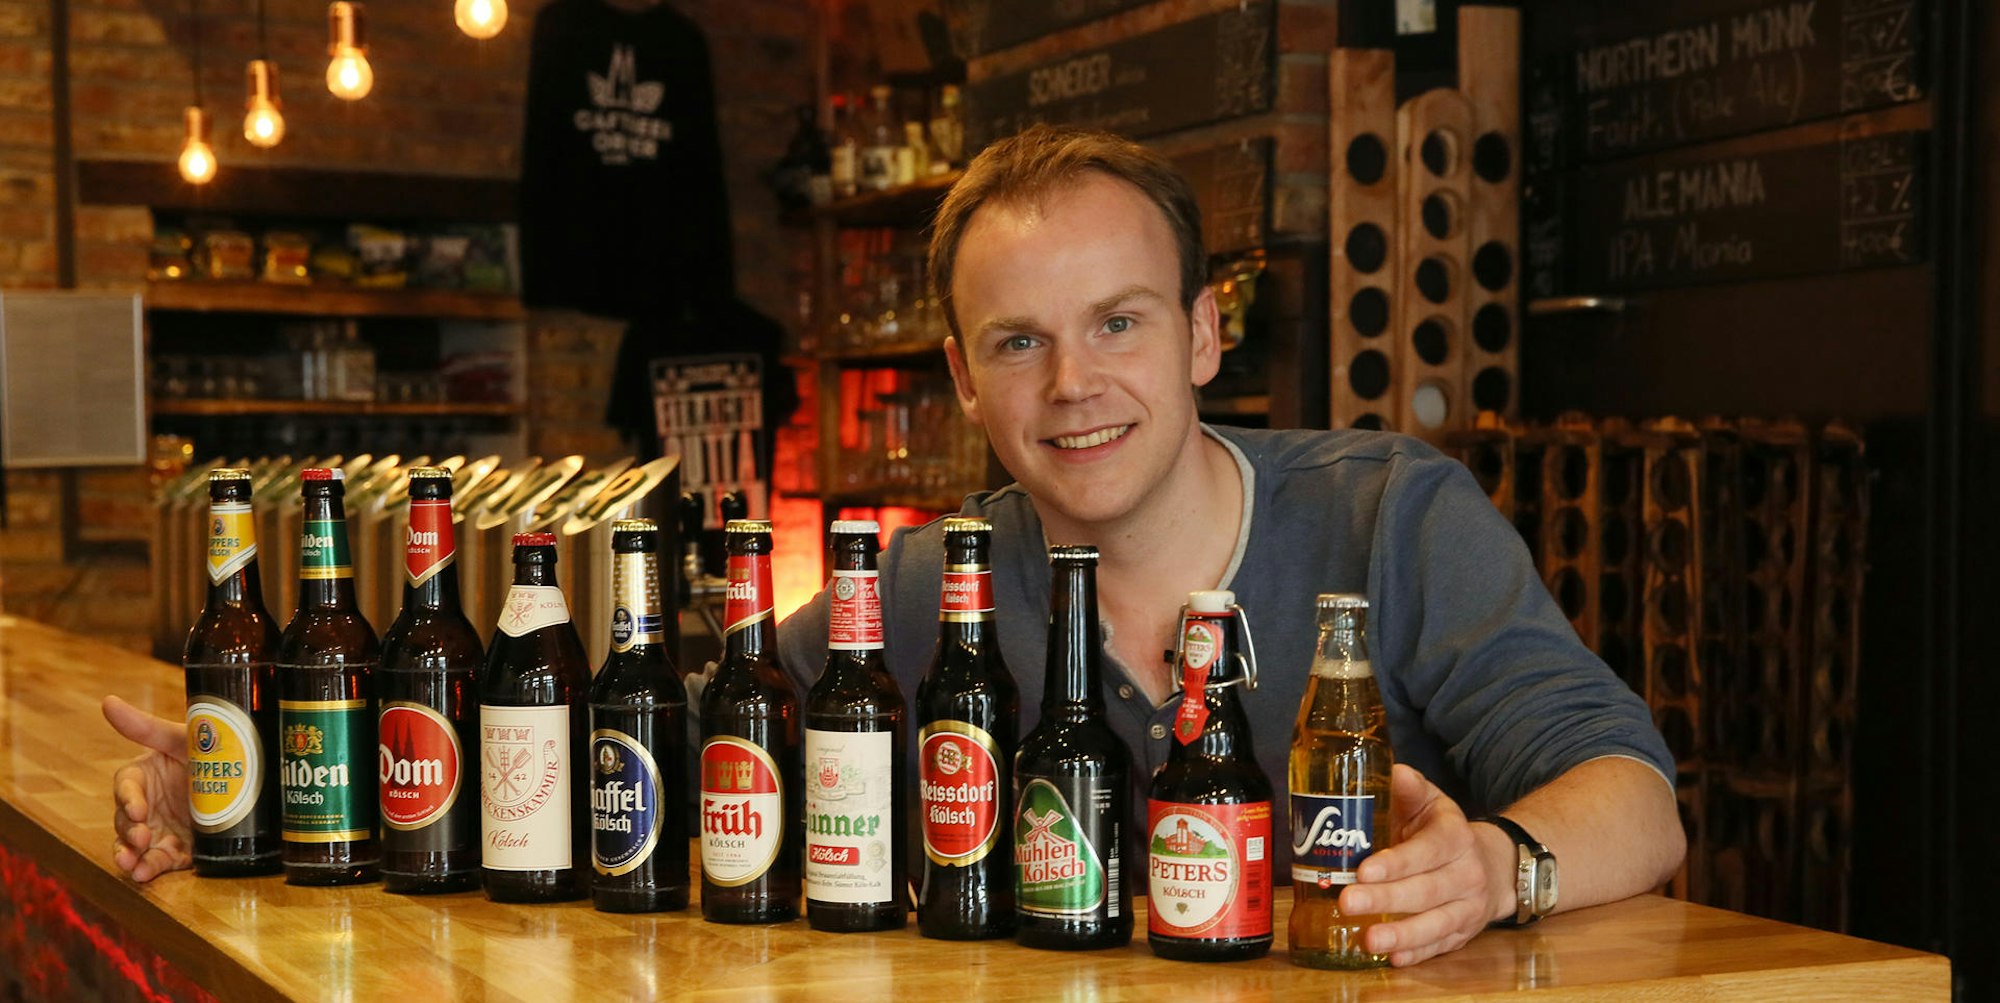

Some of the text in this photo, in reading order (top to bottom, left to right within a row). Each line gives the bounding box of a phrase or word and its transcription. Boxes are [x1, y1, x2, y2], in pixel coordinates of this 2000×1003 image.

[1576, 1, 1816, 94] NORTHERN MONK
[1622, 159, 1766, 221] ALEMANIA
[1608, 228, 1654, 280] IPA
[301, 533, 333, 548] ilden
[281, 757, 349, 788] ilden
[379, 743, 443, 786] Dom
[286, 790, 324, 805] Kölsch
[389, 789, 420, 799] KÖLSCH
[591, 780, 647, 814] affel
[920, 779, 994, 803] Reissdorf
[808, 802, 881, 837] ünner
[930, 804, 976, 828] Kölsch
[488, 829, 530, 850] Kölsch
[709, 837, 745, 848] KÖLSCH
[1292, 806, 1371, 856] Sion
[811, 847, 850, 863] Kölsch
[1015, 839, 1076, 863] Mühlen
[1023, 856, 1085, 883] Kölsch
[1151, 857, 1228, 881] PETERS
[1163, 886, 1205, 898] KÖLSCH
